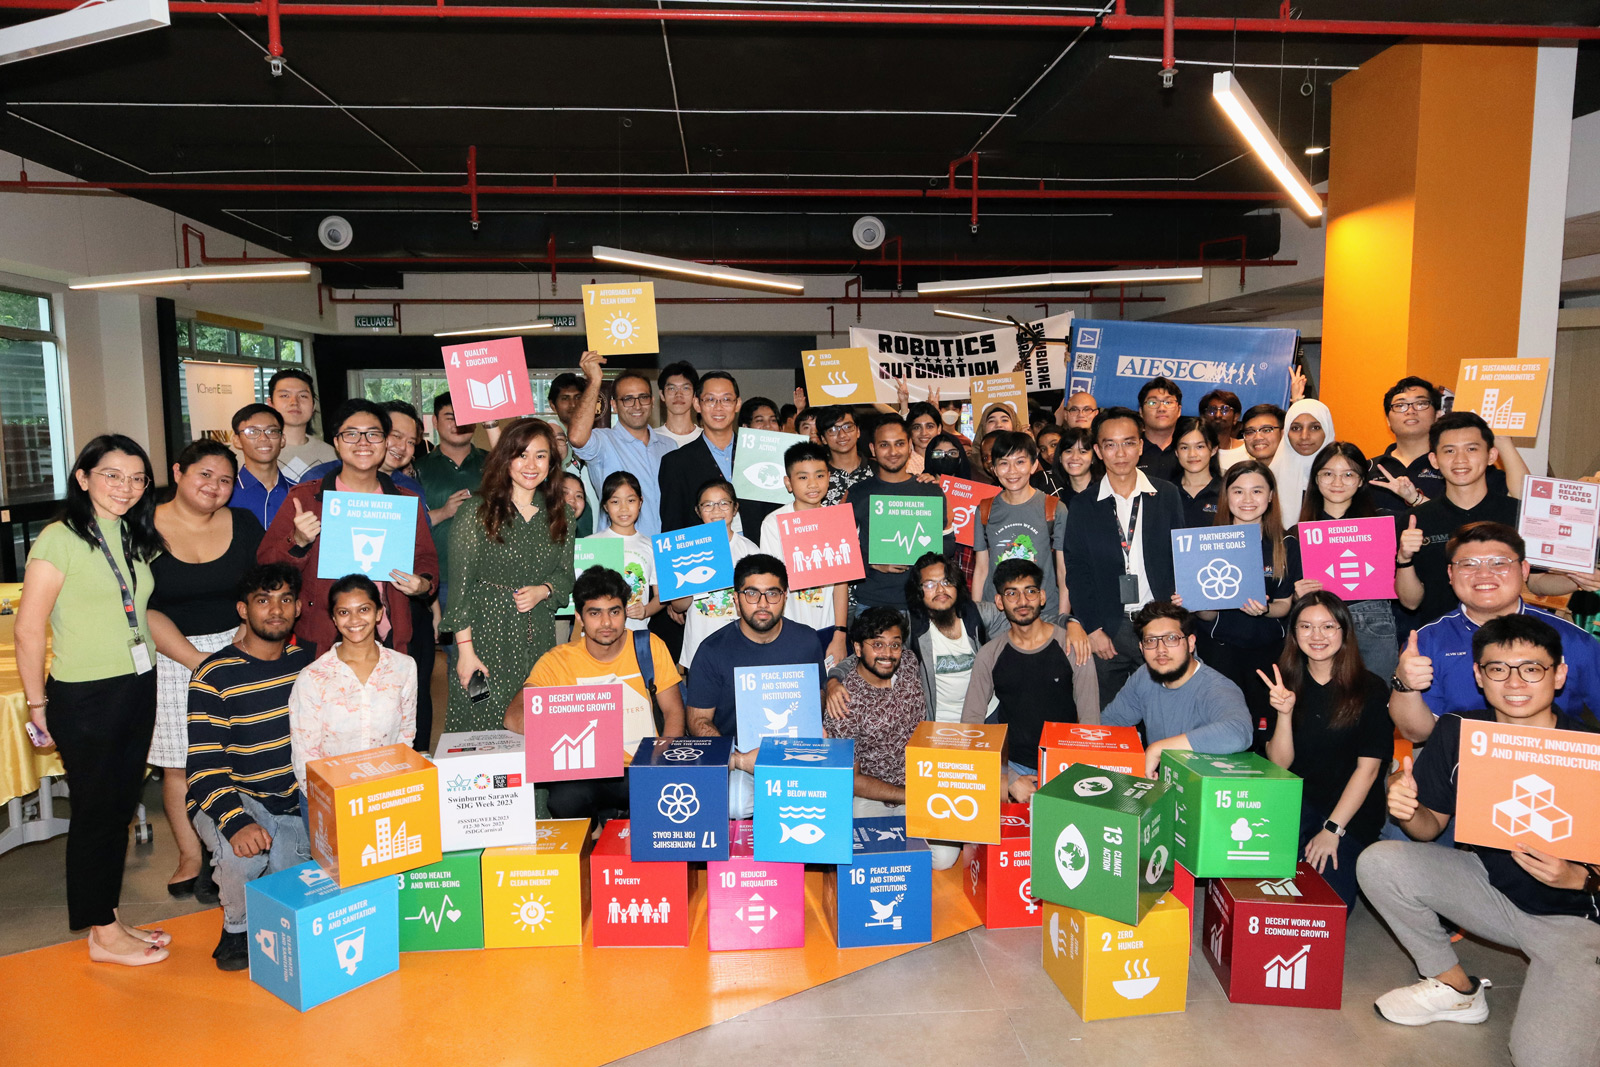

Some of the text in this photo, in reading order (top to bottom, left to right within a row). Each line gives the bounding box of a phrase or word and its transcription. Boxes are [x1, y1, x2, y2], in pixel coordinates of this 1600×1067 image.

[588, 290, 595, 306] 7
[356, 317, 387, 326] KELUAR
[878, 334, 996, 356] ROBOTICS
[450, 352, 460, 368] 4
[464, 348, 488, 358] QUALITY
[466, 356, 498, 367] EDUCATION
[808, 355, 816, 367] 2
[880, 360, 1000, 379] AUTOMATION
[1120, 358, 1208, 380] AIESEC
[1464, 365, 1478, 380] 11
[972, 381, 984, 392] 12
[742, 434, 756, 448] 13
[758, 444, 776, 452] ACTION
[942, 480, 950, 493] 5
[954, 482, 972, 491] GENDER
[1558, 489, 1592, 498] RELATED
[952, 490, 973, 500] EQUALITY
[330, 498, 341, 516] 6
[348, 499, 392, 510] CLEAN WATER
[875, 500, 884, 515] 3
[363, 510, 402, 520] SANITATION
[782, 520, 790, 536] 1
[794, 524, 818, 534] POVERTY
[1328, 526, 1358, 534] REDUCED
[1199, 530, 1245, 541] PARTNERSHIPS
[1304, 528, 1324, 545] 10
[1329, 534, 1372, 544] INEQUALITIES
[656, 538, 672, 553] 14
[676, 536, 712, 550] BELOW WATER
[1176, 534, 1193, 552] 17
[1200, 541, 1246, 551] FOR THE GOALS
[739, 674, 756, 691] 16
[761, 671, 804, 680] PEACE, JUSTICE
[549, 692, 612, 702] DECENT WORK AND
[762, 691, 802, 700] INSTITUTIONS
[532, 695, 542, 714] 8
[549, 702, 616, 714] ECONOMIC GROWTH
[1470, 730, 1488, 756] 9
[1492, 732, 1543, 750] INDUSTRY,
[1492, 748, 1512, 760] AND
[917, 760, 933, 778] 12
[938, 762, 974, 771] RESPONSIBLE
[938, 772, 977, 780] CONSUMPTION
[765, 780, 782, 796] 14
[950, 781, 986, 790] PRODUCTION
[368, 784, 424, 802] SUSTAINABLE CITIES
[448, 792, 518, 804] Swinburne Sarawak
[1214, 790, 1232, 808] 15
[1236, 790, 1248, 798] LIFE
[348, 797, 364, 816] 11
[368, 794, 422, 812] AND COMMUNITIES
[702, 832, 718, 848] 17
[1103, 826, 1122, 845] 13
[1000, 852, 1008, 868] 5
[1102, 848, 1111, 872] ACTION
[1113, 850, 1122, 878] CLIMATE
[602, 869, 610, 885] 1
[850, 868, 866, 885] 16
[870, 865, 912, 876] PEACE, JUSTICE
[425, 880, 460, 888] WELL-BEING
[496, 870, 504, 888] 7
[720, 872, 736, 888] 10
[740, 880, 778, 888] INEQUALITIES
[870, 884, 908, 893] INSTITUTIONS
[328, 899, 368, 920] CLEAN WATER
[328, 906, 376, 930] AND SANITATION
[1248, 916, 1260, 934] 8
[1265, 917, 1290, 926] DECENT
[1290, 918, 1311, 927] WORK
[312, 917, 322, 936] 6
[1264, 928, 1330, 938] ECONOMIC GROWTH
[1102, 932, 1112, 952] 2
[1118, 930, 1134, 940] ZERO
[1118, 940, 1144, 950] HUNGER
